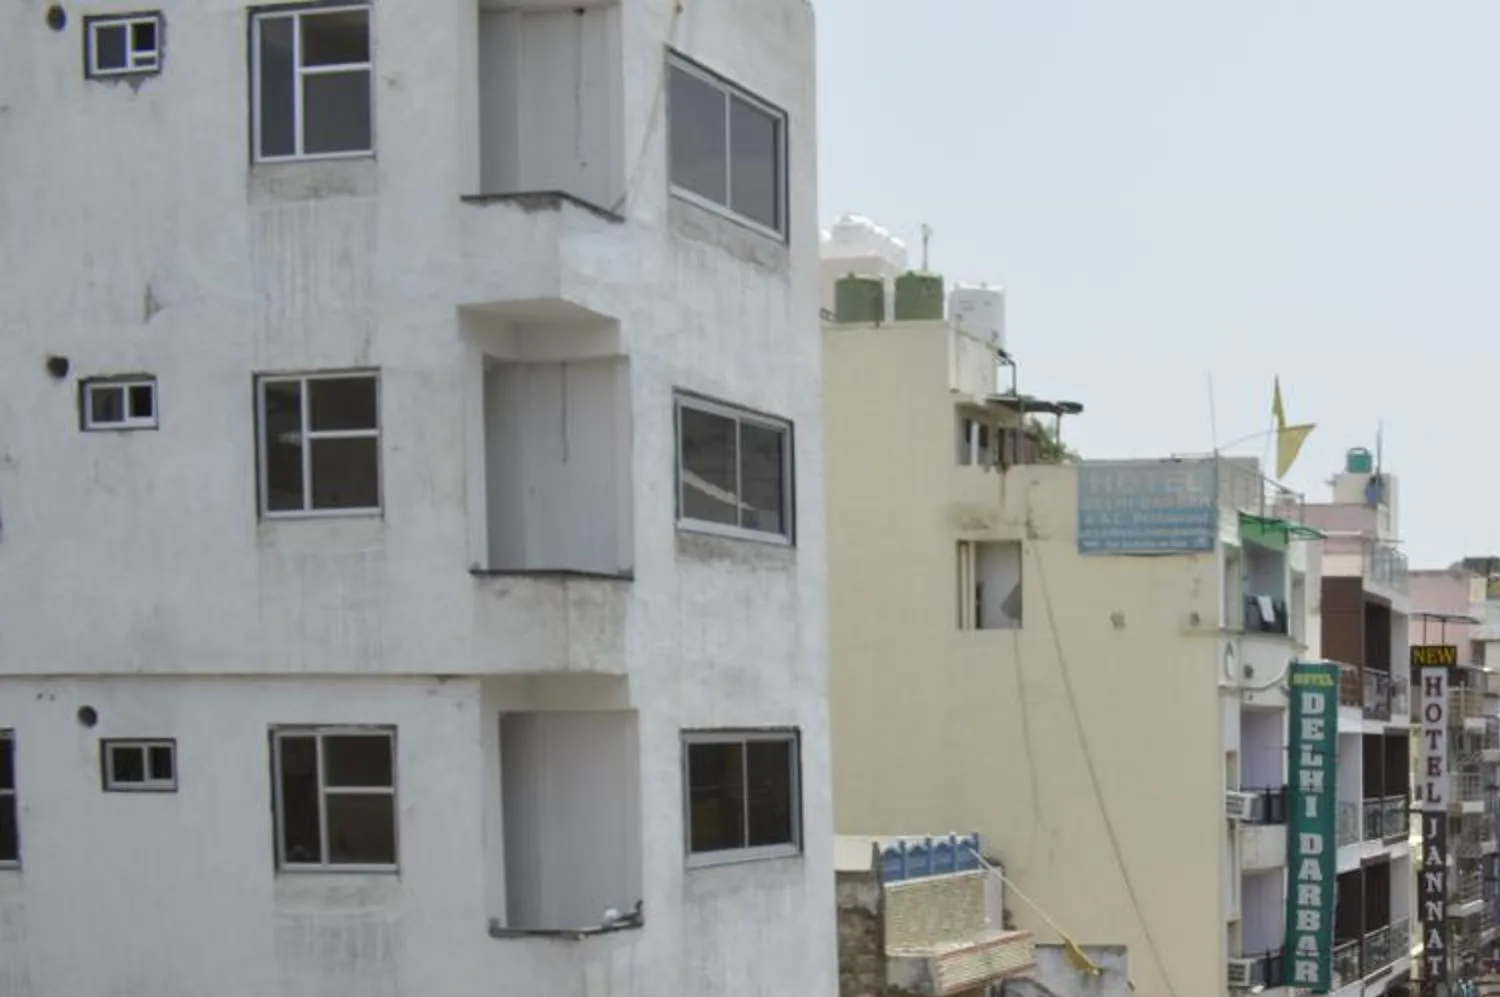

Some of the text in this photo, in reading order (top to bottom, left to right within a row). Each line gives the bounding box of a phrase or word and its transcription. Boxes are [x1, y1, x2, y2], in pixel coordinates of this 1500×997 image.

[1413, 647, 1454, 665] NEW
[1295, 692, 1325, 983] DELHI DARBAR
[1424, 676, 1444, 976] HOTEL JANNAT
